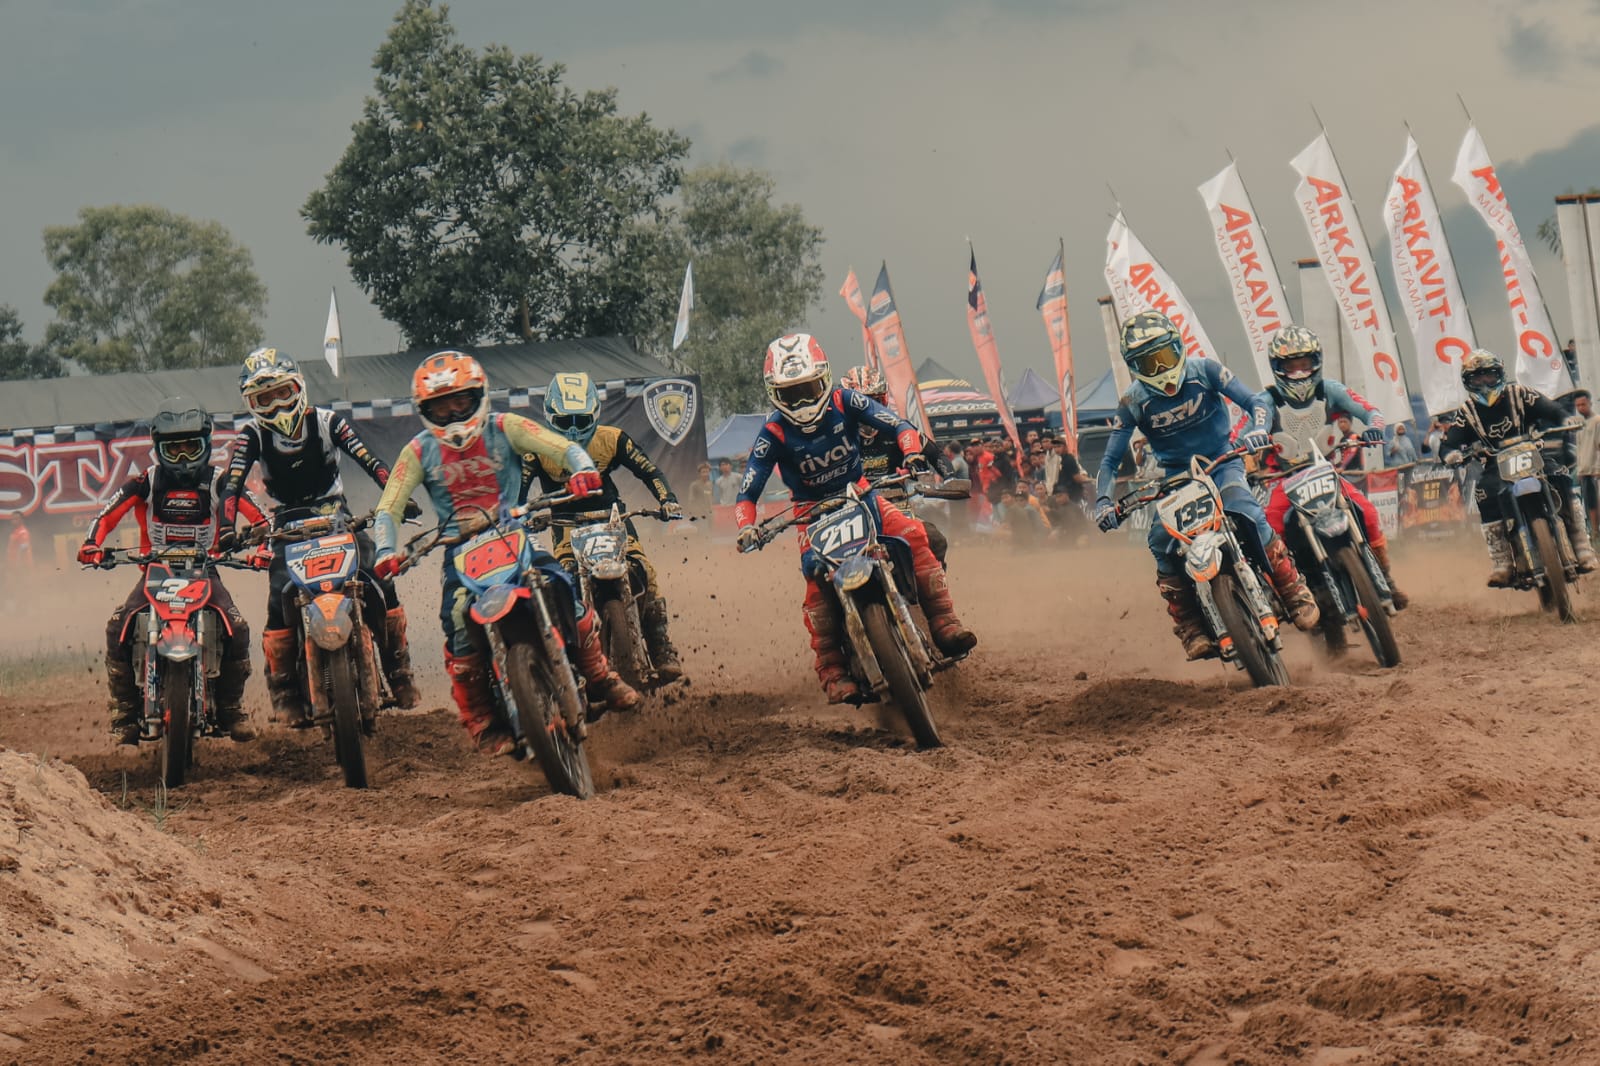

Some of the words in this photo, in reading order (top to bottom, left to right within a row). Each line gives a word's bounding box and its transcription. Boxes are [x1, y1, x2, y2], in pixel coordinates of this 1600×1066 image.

[1303, 200, 1361, 330] MULTIVITAMIN
[1306, 175, 1399, 383] ARKAVIT-C
[1397, 175, 1471, 365] ARKAVIT-C
[1217, 227, 1265, 352] MULTIVITAMIN
[800, 436, 855, 474] rival
[1508, 452, 1533, 475] 16
[1296, 474, 1335, 506] 305
[1174, 494, 1214, 531] 135
[583, 535, 617, 560] 15
[820, 514, 864, 555] 211
[303, 551, 346, 579] 127
[156, 579, 208, 601] 34
